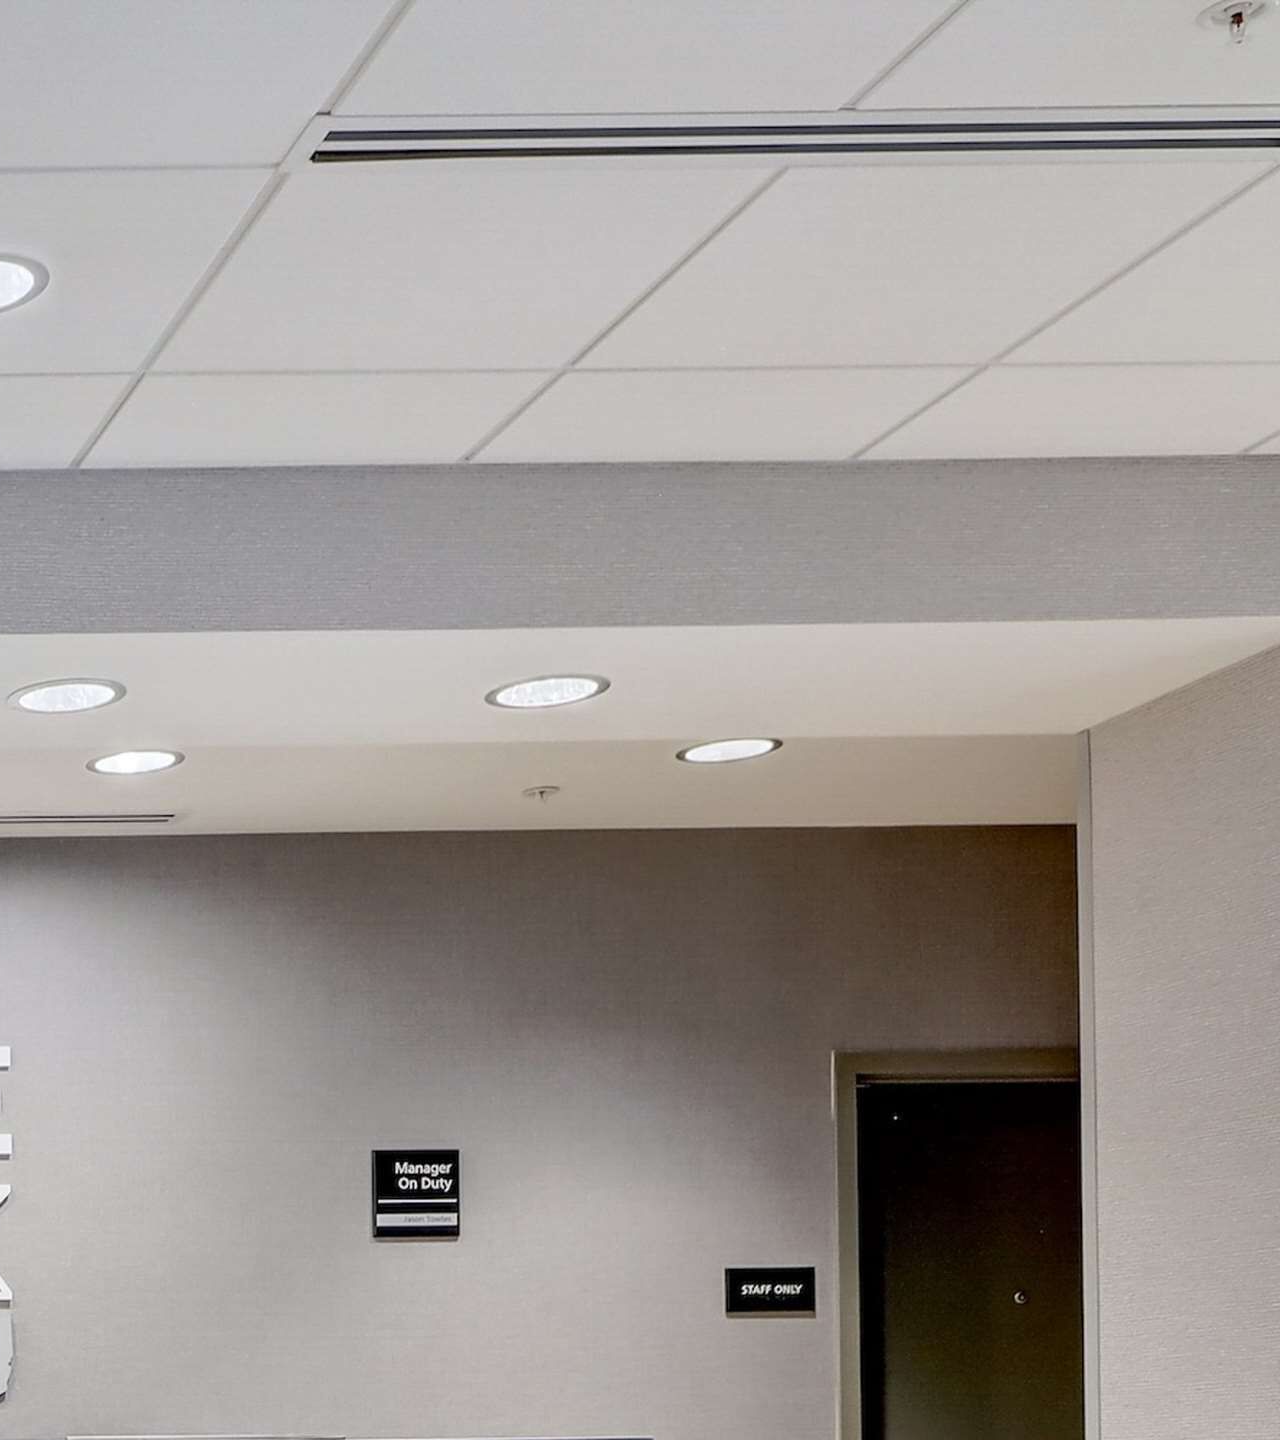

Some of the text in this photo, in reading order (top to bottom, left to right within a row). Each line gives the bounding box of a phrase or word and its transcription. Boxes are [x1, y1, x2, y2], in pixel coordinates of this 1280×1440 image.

[395, 1161, 452, 1177] Manager
[398, 1176, 453, 1192] On Duty
[741, 1284, 803, 1295] STAFF ONLY
